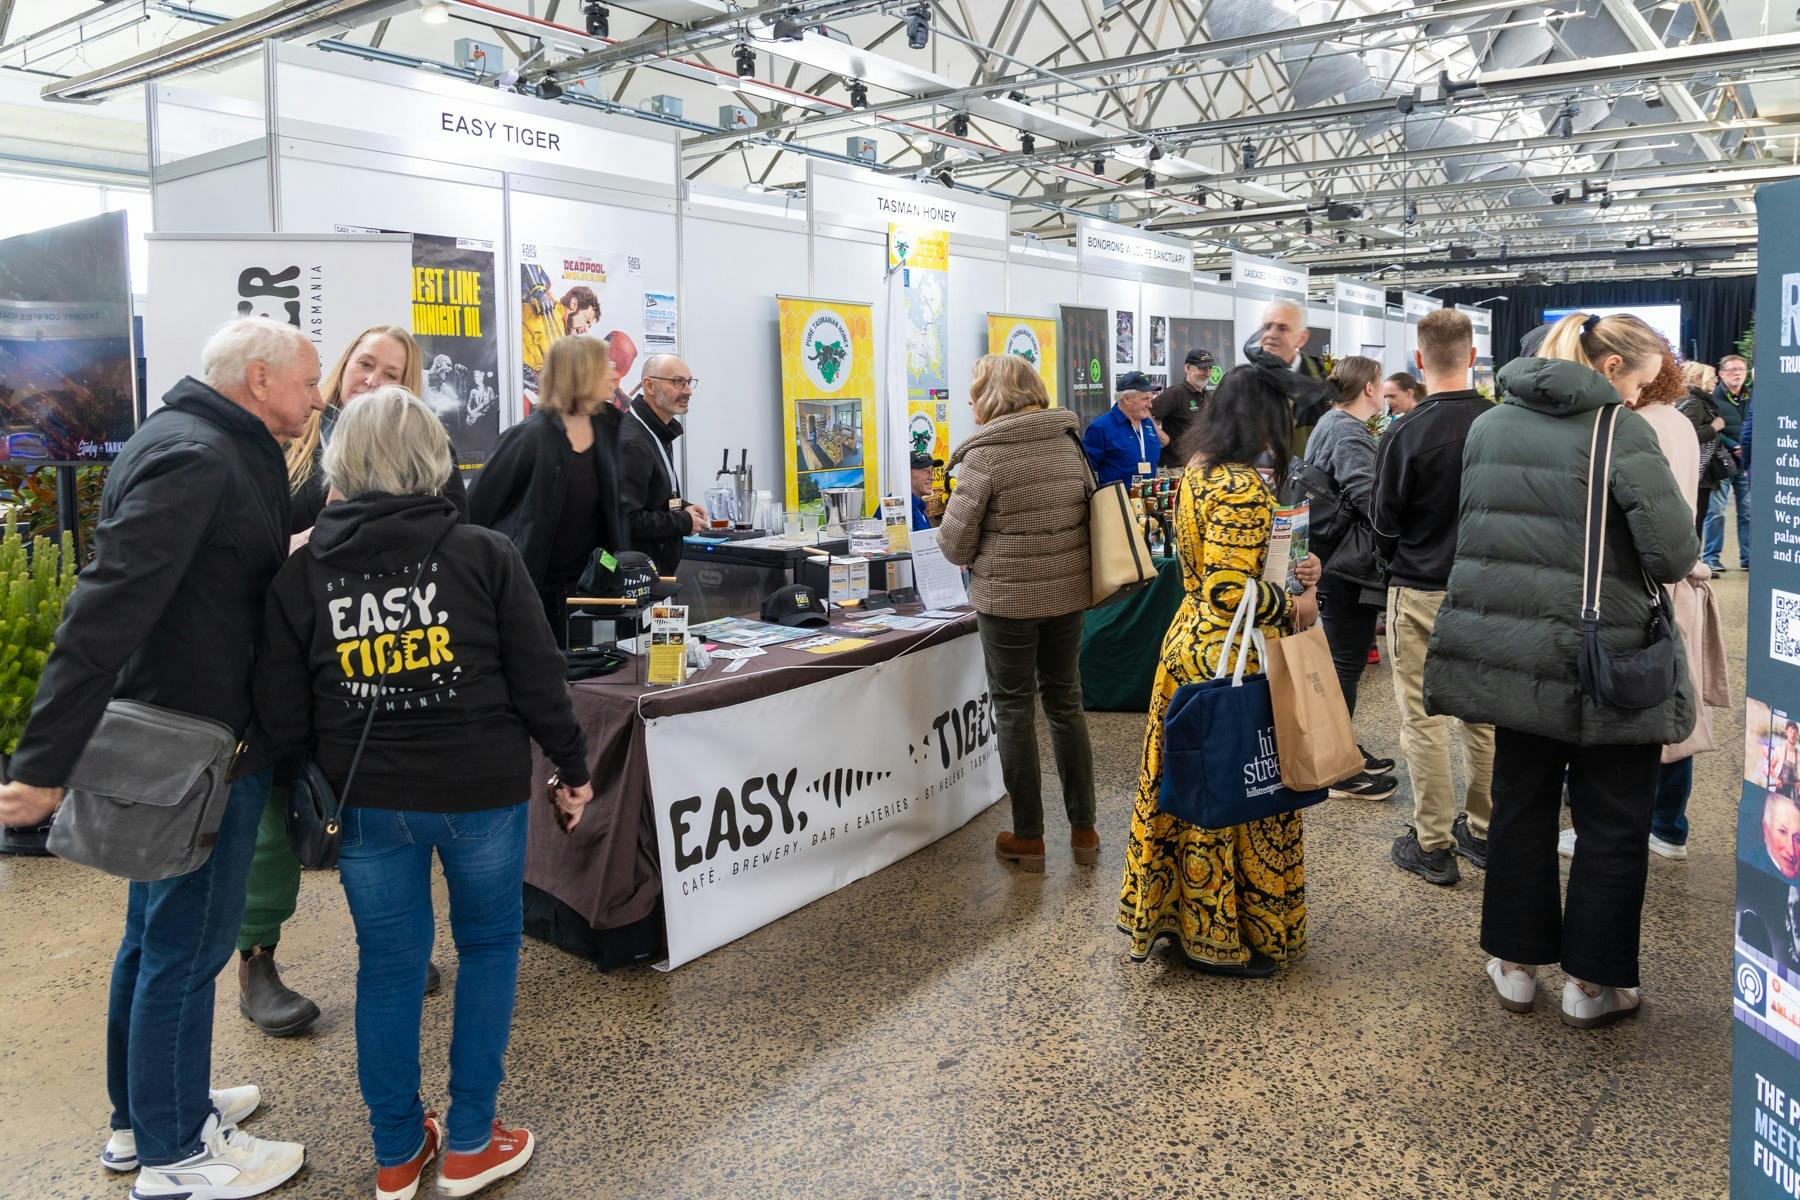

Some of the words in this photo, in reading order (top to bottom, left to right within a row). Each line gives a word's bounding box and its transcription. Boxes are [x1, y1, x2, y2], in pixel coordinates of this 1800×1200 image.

[441, 112, 496, 139] EASY
[503, 124, 561, 151] TIGER
[877, 197, 920, 217] TASMAN
[922, 206, 956, 223] HONEY
[1087, 237, 1124, 254] BONORONG
[1153, 249, 1186, 264] SANCTUARY
[563, 259, 605, 274] DEADPOOL
[448, 269, 481, 306] LINE
[310, 265, 323, 343] TASMANIA
[463, 306, 483, 338] OIL
[806, 328, 815, 347] PURE
[812, 316, 839, 329] TASMANIAN
[838, 326, 849, 348] HONEY
[1780, 356, 1800, 374] TRU
[1777, 415, 1798, 430] The
[104, 441, 126, 454] TARK
[1777, 434, 1799, 449] take
[1776, 453, 1787, 467] of
[1775, 509, 1791, 524] We
[1773, 549, 1792, 563] and
[327, 577, 346, 592] ST
[363, 562, 438, 581] HES
[328, 582, 449, 640] EASY,
[336, 625, 454, 678] TIGER
[344, 688, 457, 711] TAMANIA
[669, 767, 808, 873] EASY,
[811, 827, 836, 847] BAR
[857, 798, 909, 830] EATERIES
[924, 785, 935, 800] ST
[1755, 1072, 1785, 1119] THE
[1789, 1098, 1800, 1132] P
